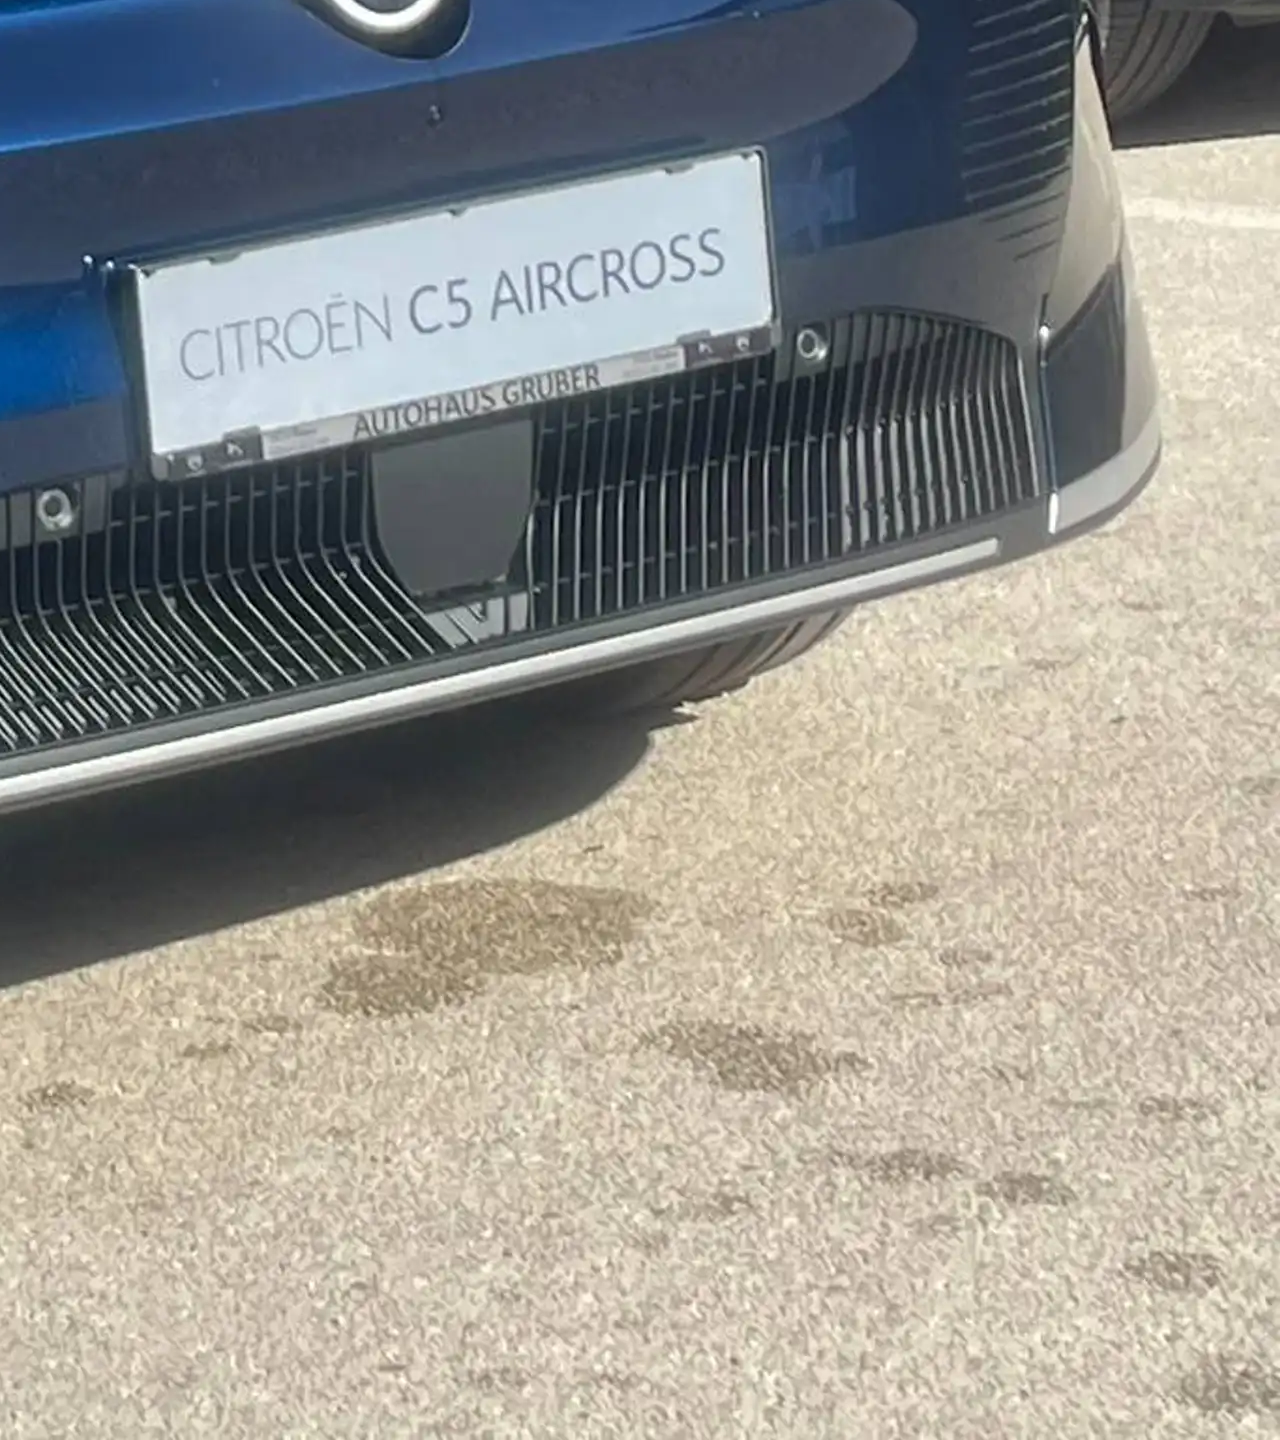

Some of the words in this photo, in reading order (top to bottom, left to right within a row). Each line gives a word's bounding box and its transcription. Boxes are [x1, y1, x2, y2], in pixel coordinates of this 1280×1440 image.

[180, 292, 393, 381] CITROËN
[409, 279, 472, 334] C5
[490, 228, 725, 321] AIRCROSS
[353, 389, 496, 440] AUTOHAUS
[502, 364, 600, 407] GRUBER
